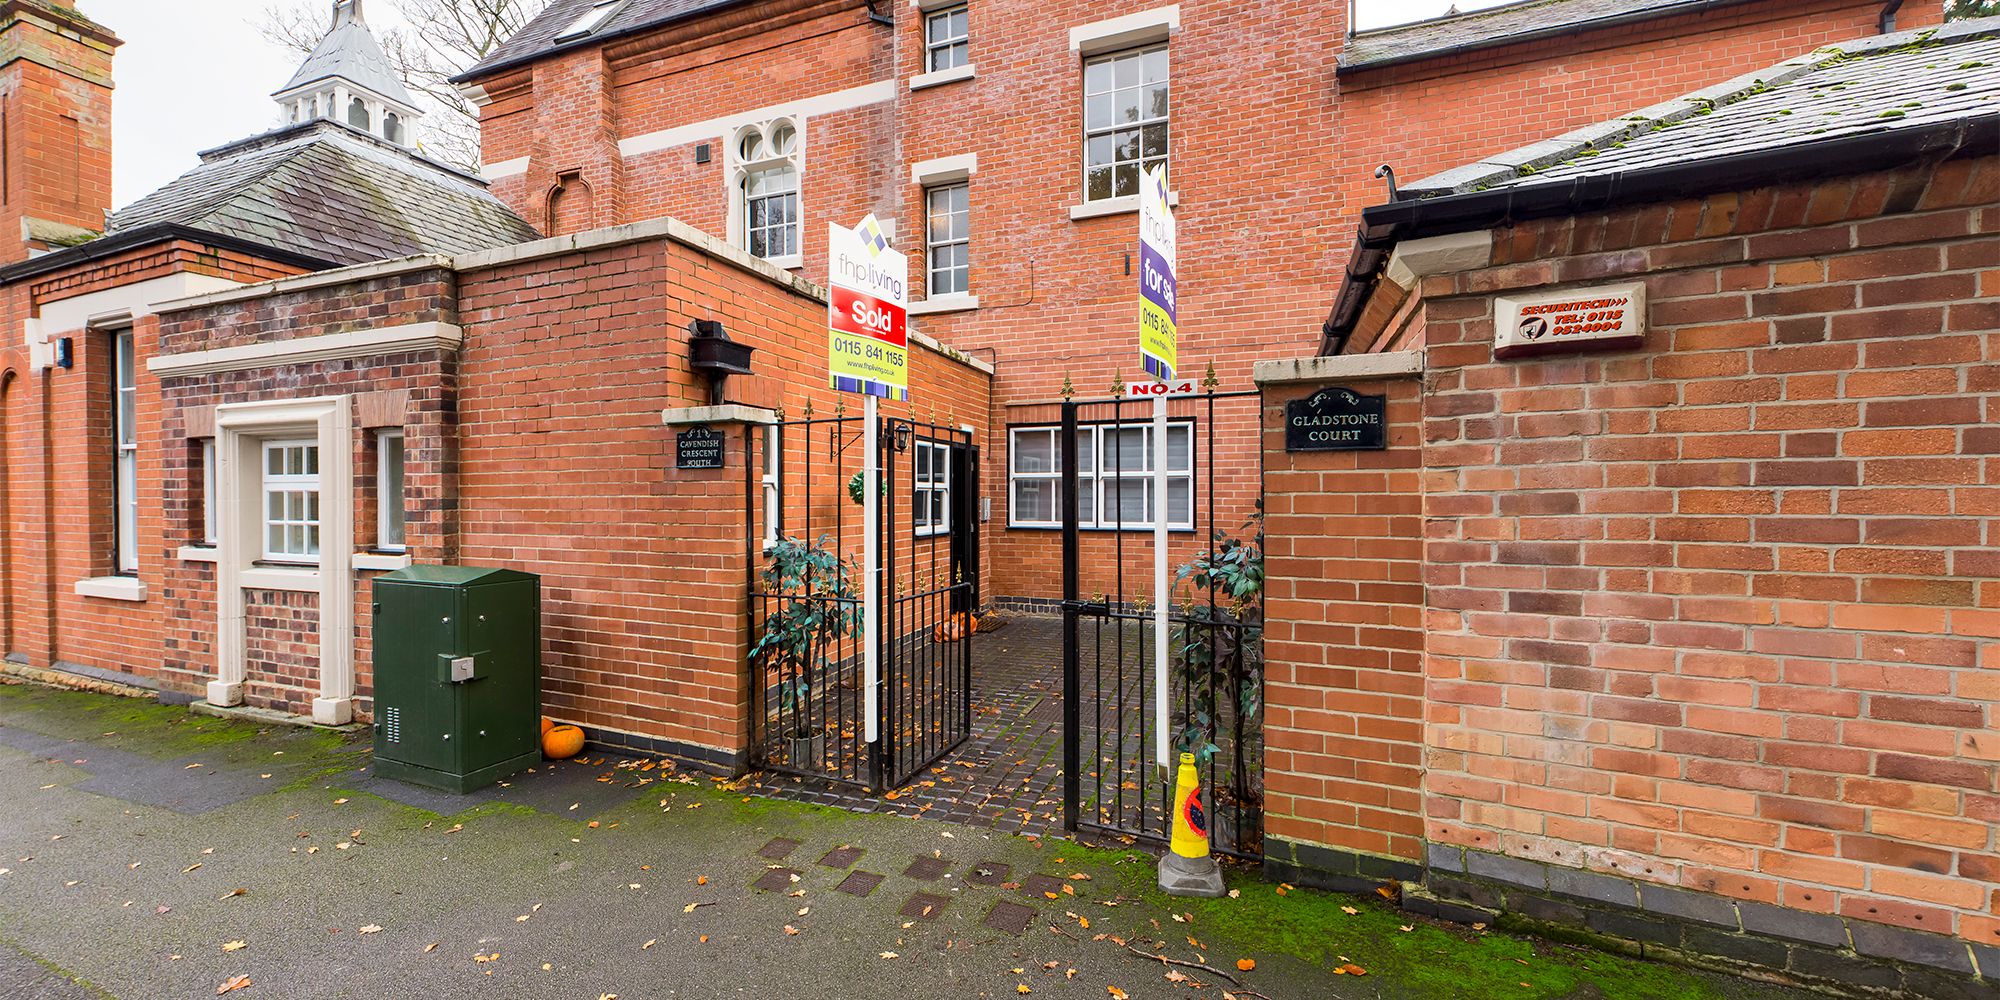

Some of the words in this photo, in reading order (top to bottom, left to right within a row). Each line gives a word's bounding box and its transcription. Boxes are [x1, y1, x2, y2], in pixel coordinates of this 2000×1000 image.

[1144, 258, 1163, 294] for
[1520, 299, 1610, 316] SECURITECH
[852, 300, 892, 333] Sold
[1143, 307, 1159, 331] 0115
[1554, 314, 1584, 325] TEL:
[1586, 309, 1624, 323] 0115
[1552, 320, 1622, 336] 9524004
[834, 337, 861, 356] 0115
[866, 344, 883, 361] 841
[886, 350, 904, 367] 1155
[1132, 382, 1193, 395] NO.4
[1292, 413, 1379, 427] GLADSTONE
[1308, 430, 1361, 441] COURT
[680, 440, 720, 449] CAVENDISH
[681, 449, 718, 458] CRESCENT
[687, 459, 712, 467] SOUTH
